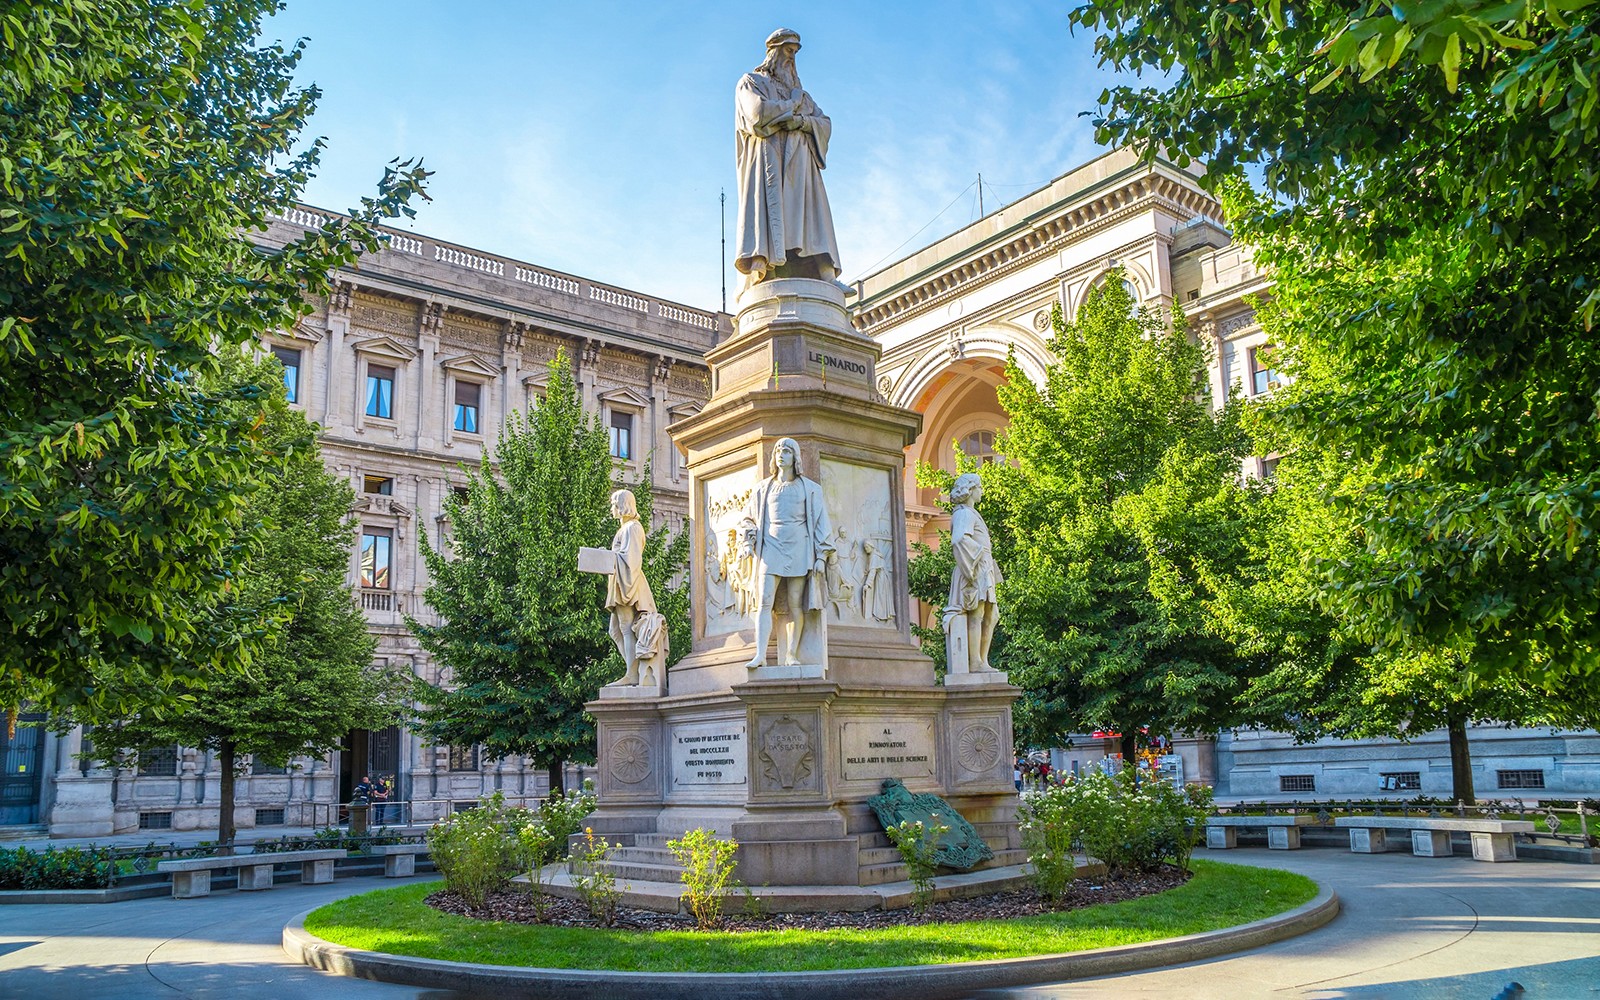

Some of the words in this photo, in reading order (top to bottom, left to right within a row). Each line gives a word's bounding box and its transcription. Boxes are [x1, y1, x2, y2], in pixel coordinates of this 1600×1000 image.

[808, 351, 866, 375] LEONARDO
[779, 743, 806, 752] SESTO
[868, 741, 907, 749] RINNOVATORE
[866, 756, 880, 764] ARTI
